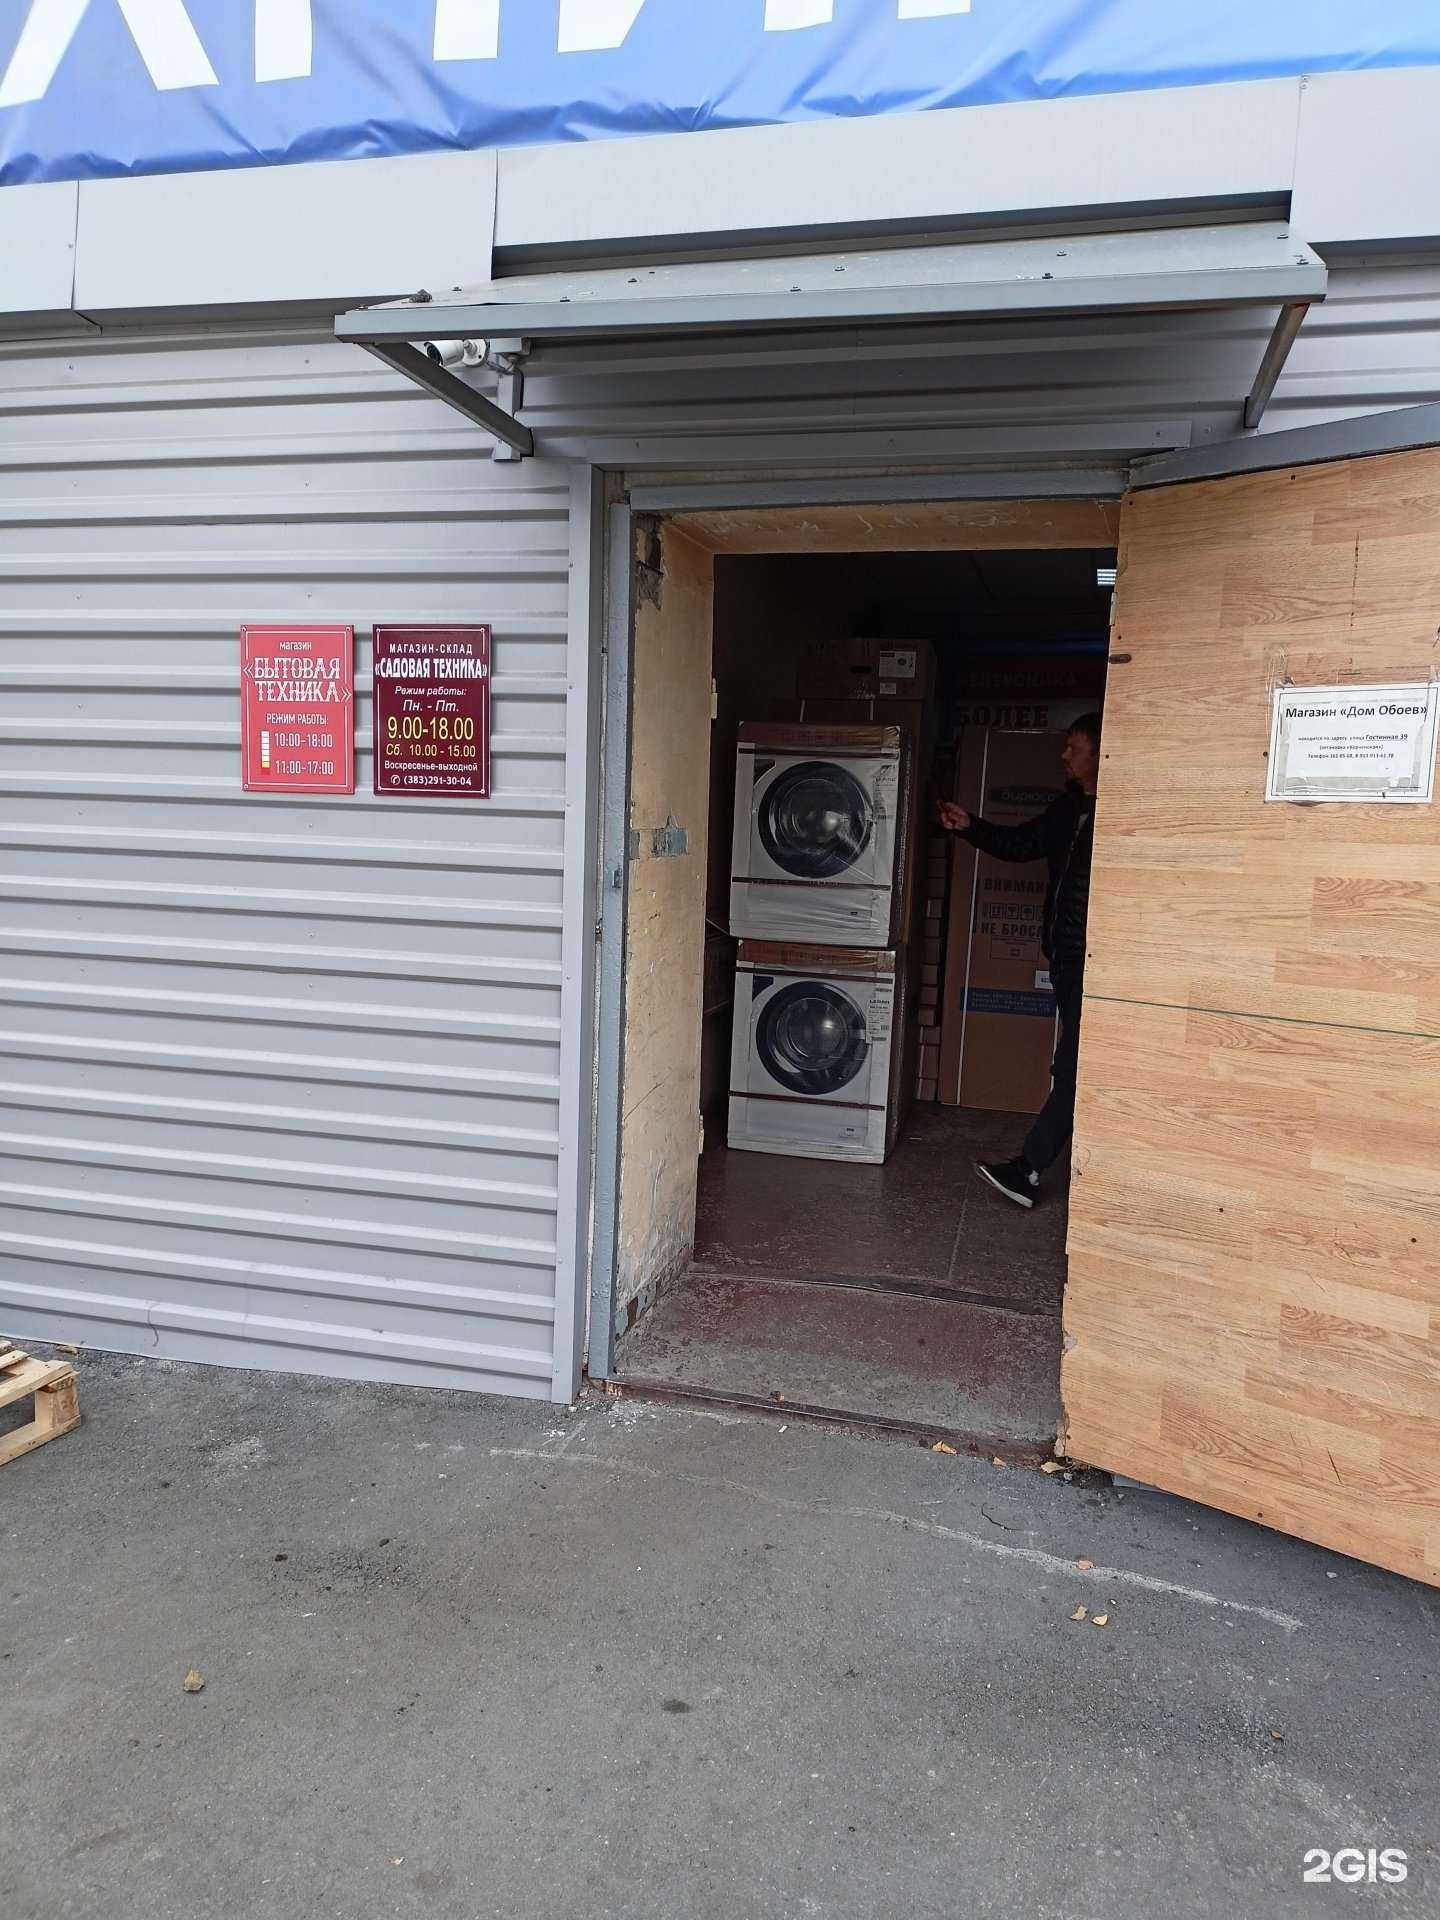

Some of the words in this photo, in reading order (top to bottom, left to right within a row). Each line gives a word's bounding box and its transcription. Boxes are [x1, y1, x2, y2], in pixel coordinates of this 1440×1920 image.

[279, 641, 313, 651] магазин
[389, 643, 473, 655] МАГАЗИН-СКЛАД
[243, 657, 340, 679] «БЫТОВАЯ
[375, 657, 430, 678] «САДОВАЯ
[433, 658, 488, 679] ТЕХНИКА»
[255, 680, 353, 702] ТЕХНИКА»
[394, 685, 425, 695] Режим
[427, 686, 467, 697] работы:
[402, 699, 423, 712] Пн.
[435, 700, 460, 712] Пт.
[1285, 707, 1337, 719] Магазин
[1340, 705, 1375, 719] «Дом
[1378, 704, 1428, 716] Обоев»
[266, 713, 296, 724] РЕЖИМ
[297, 714, 329, 725] РАБОТЫ:
[387, 716, 474, 740] 9.00-18.00
[386, 743, 403, 756] Сб.
[409, 744, 438, 756] 10.00
[447, 745, 476, 757] 15.00
[384, 760, 478, 772] Воскресенье-выходной
[403, 775, 472, 786] (383)291-30-04
